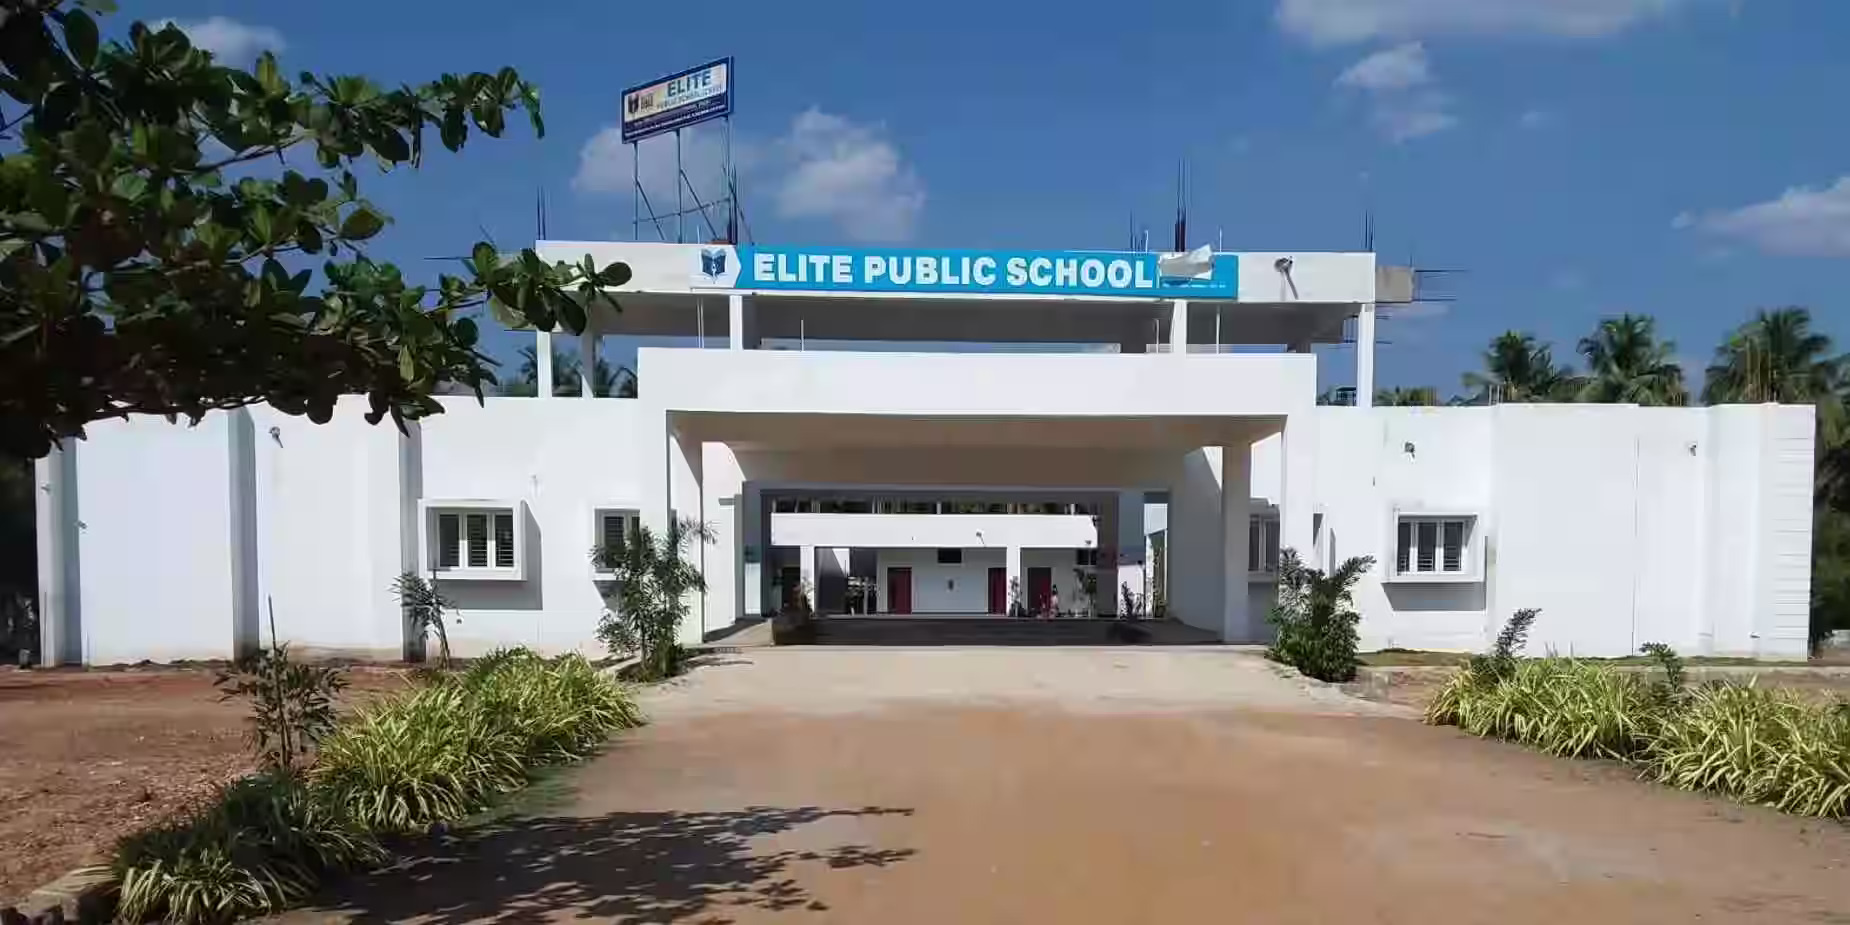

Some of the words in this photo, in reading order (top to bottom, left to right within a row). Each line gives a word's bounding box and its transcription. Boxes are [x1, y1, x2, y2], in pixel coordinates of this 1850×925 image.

[667, 69, 712, 97] ELITE
[753, 252, 853, 283] ELITE
[864, 255, 997, 286] PUBLIC
[1006, 256, 1153, 288] SCHOOL
